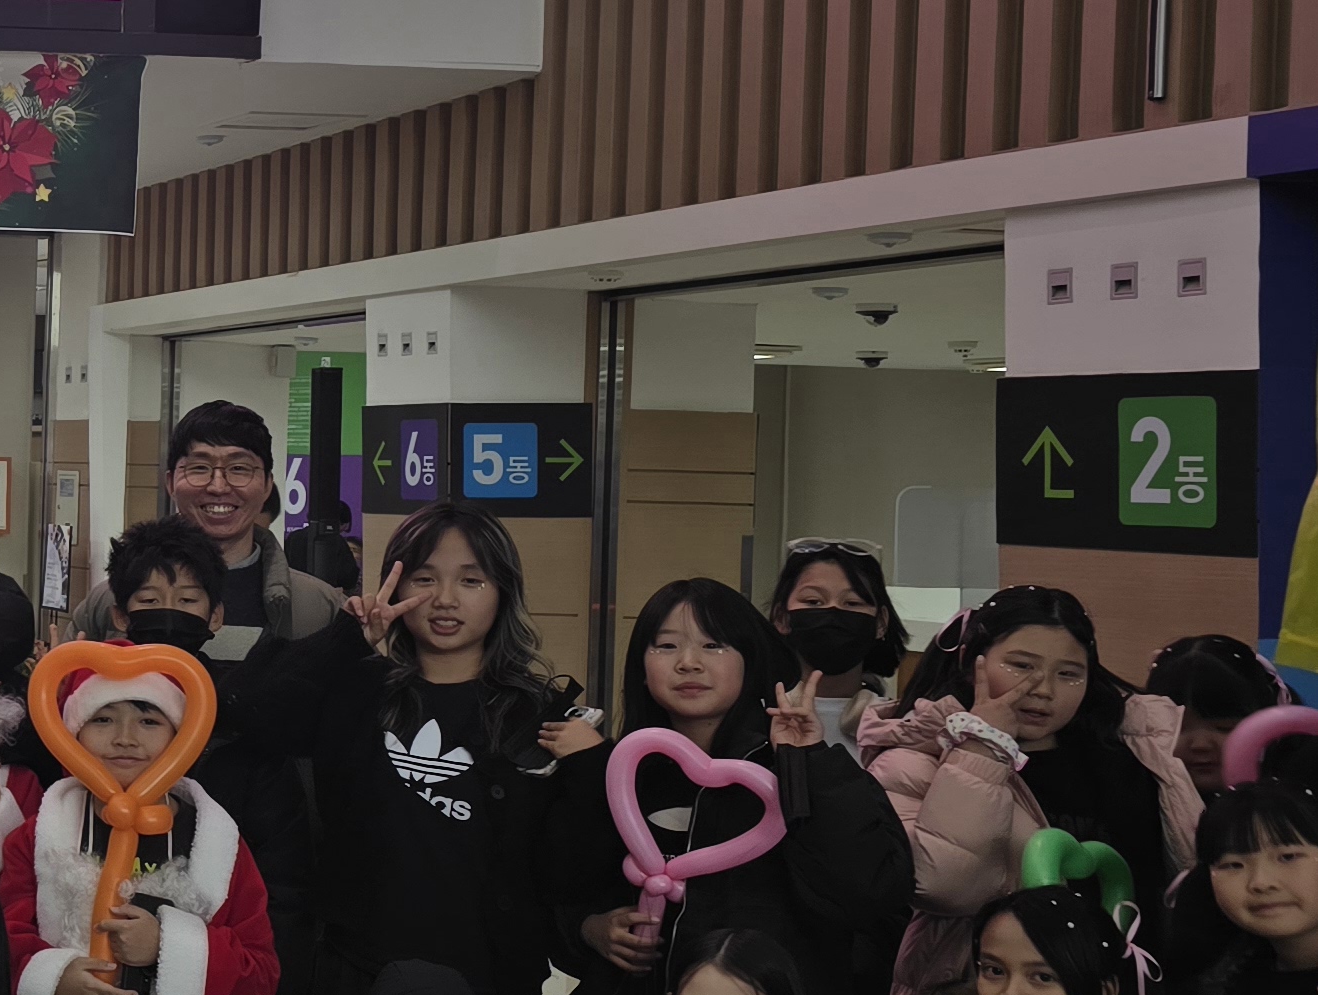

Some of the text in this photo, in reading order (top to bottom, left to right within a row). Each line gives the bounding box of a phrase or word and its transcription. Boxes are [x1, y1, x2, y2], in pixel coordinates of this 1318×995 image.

[405, 431, 436, 487] 6동
[472, 434, 532, 485] 5동
[1130, 416, 1208, 504] 2동
